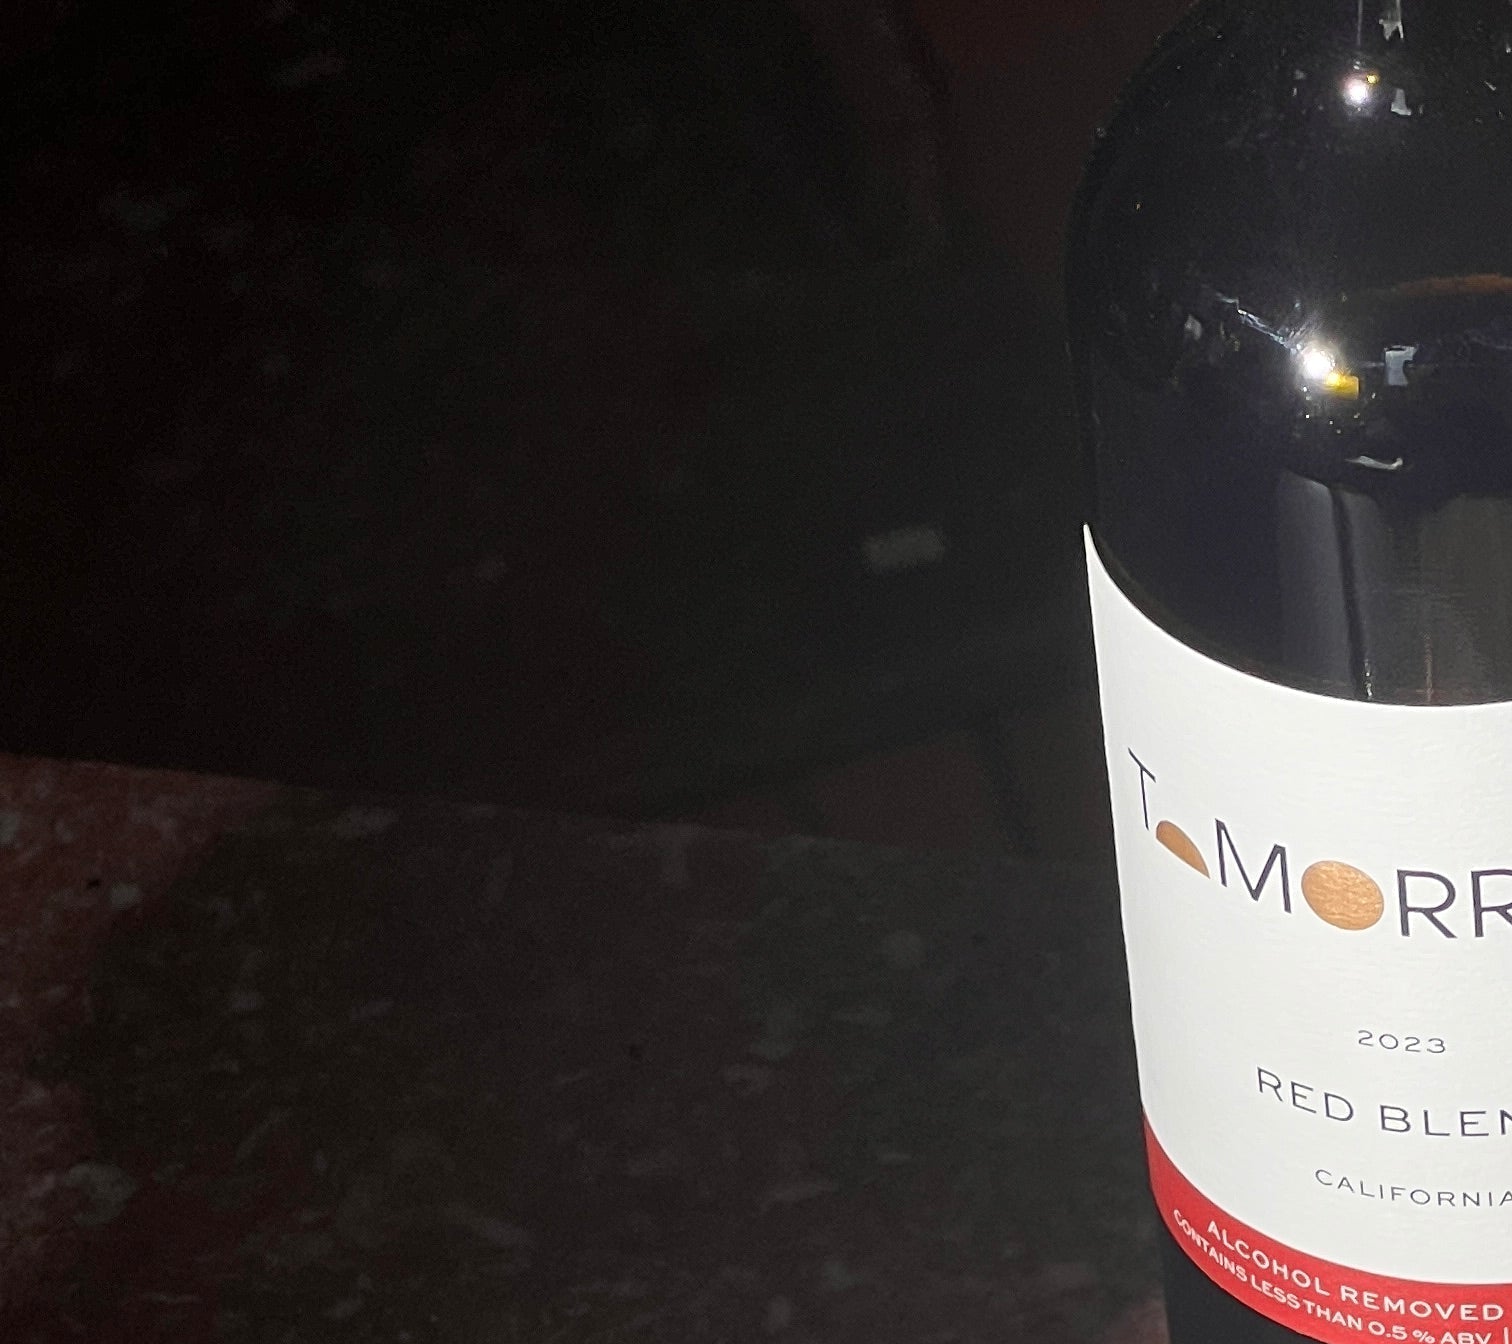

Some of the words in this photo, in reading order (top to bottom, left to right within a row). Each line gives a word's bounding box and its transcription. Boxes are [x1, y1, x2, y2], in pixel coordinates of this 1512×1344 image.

[1357, 1030, 1447, 1054] 2023
[1256, 1066, 1355, 1123] RED
[1172, 1208, 1249, 1283] CONTAINS
[1250, 1274, 1300, 1311] LESS
[1300, 1301, 1363, 1332] THAN
[1367, 1320, 1408, 1341] 0.5
[1206, 1219, 1331, 1297] ALCOHOL
[1339, 1285, 1504, 1322] REMOVED
